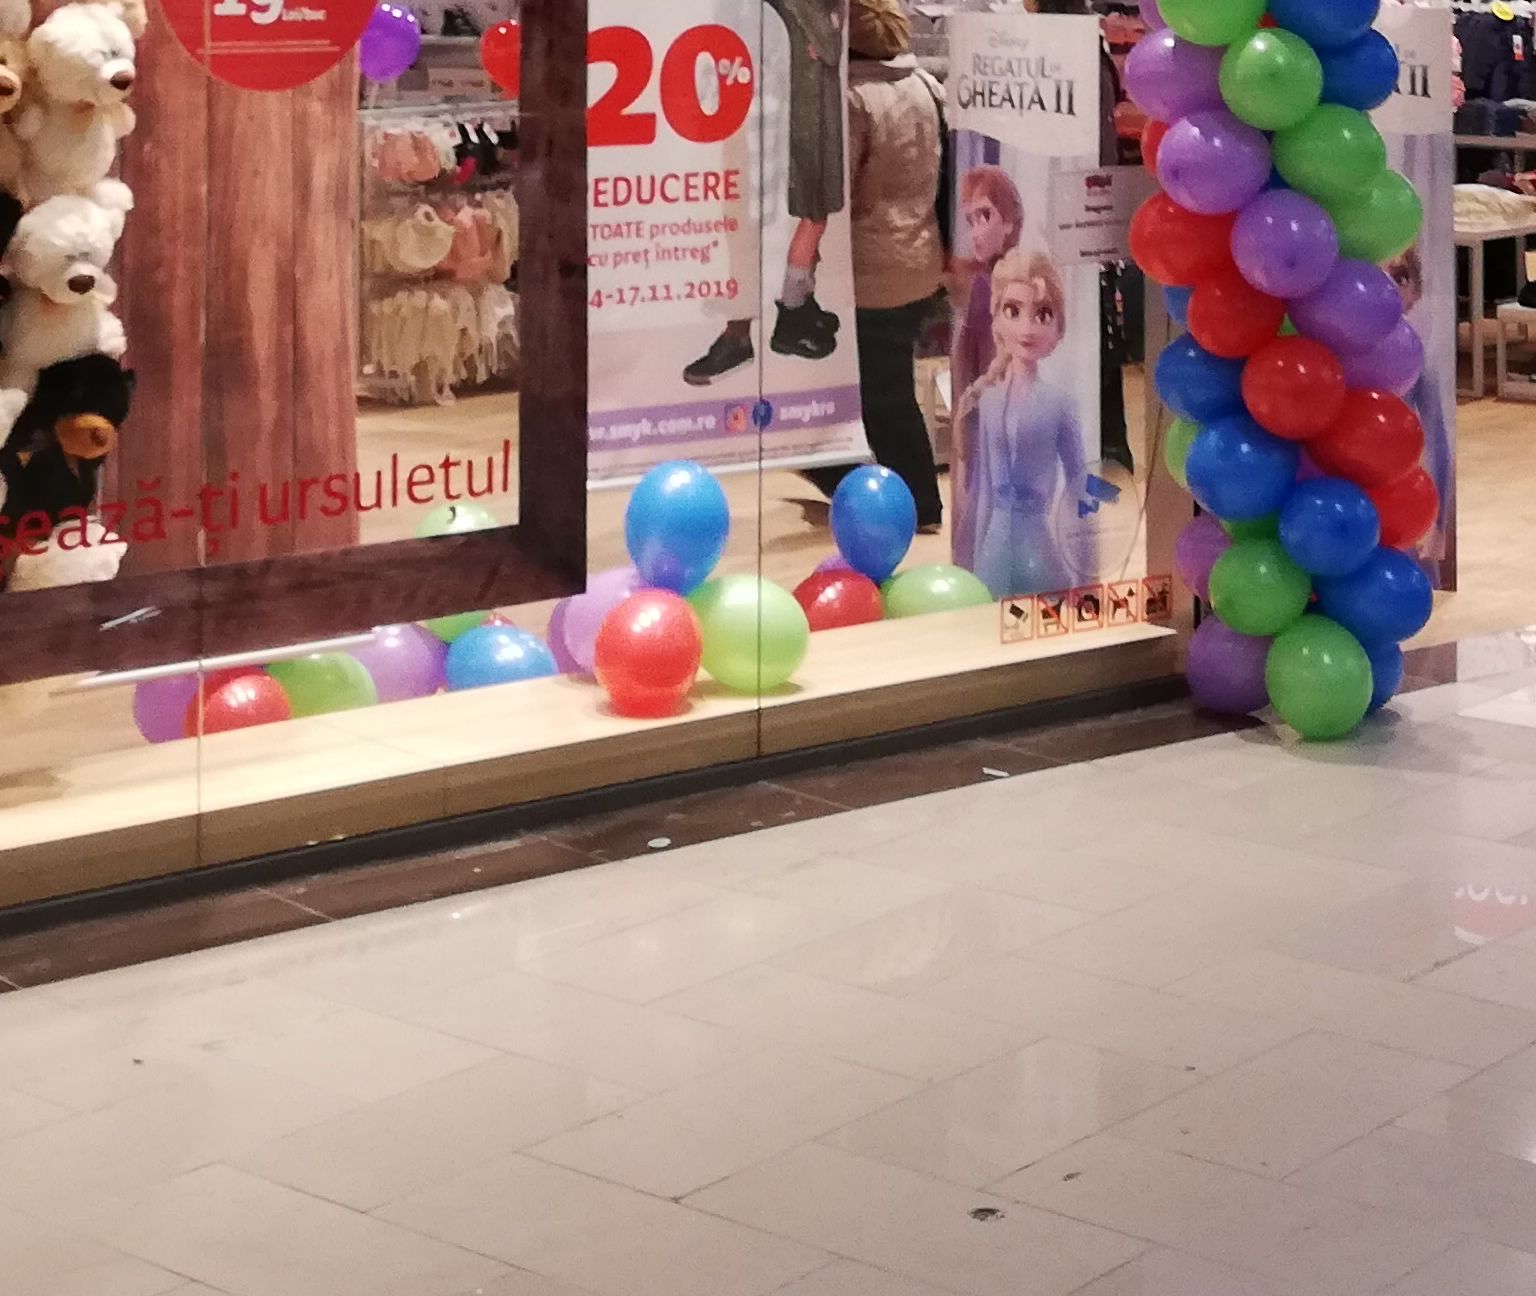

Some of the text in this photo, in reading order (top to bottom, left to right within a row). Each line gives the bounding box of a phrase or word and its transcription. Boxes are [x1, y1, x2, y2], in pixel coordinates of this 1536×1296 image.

[971, 52, 1052, 79] REGATUL
[1054, 79, 1077, 117] II
[593, 169, 741, 208] EDUCERE
[590, 215, 739, 241] TOATE produsele
[589, 276, 739, 309] 4-17.11.2019
[258, 438, 511, 526] ursulețul
